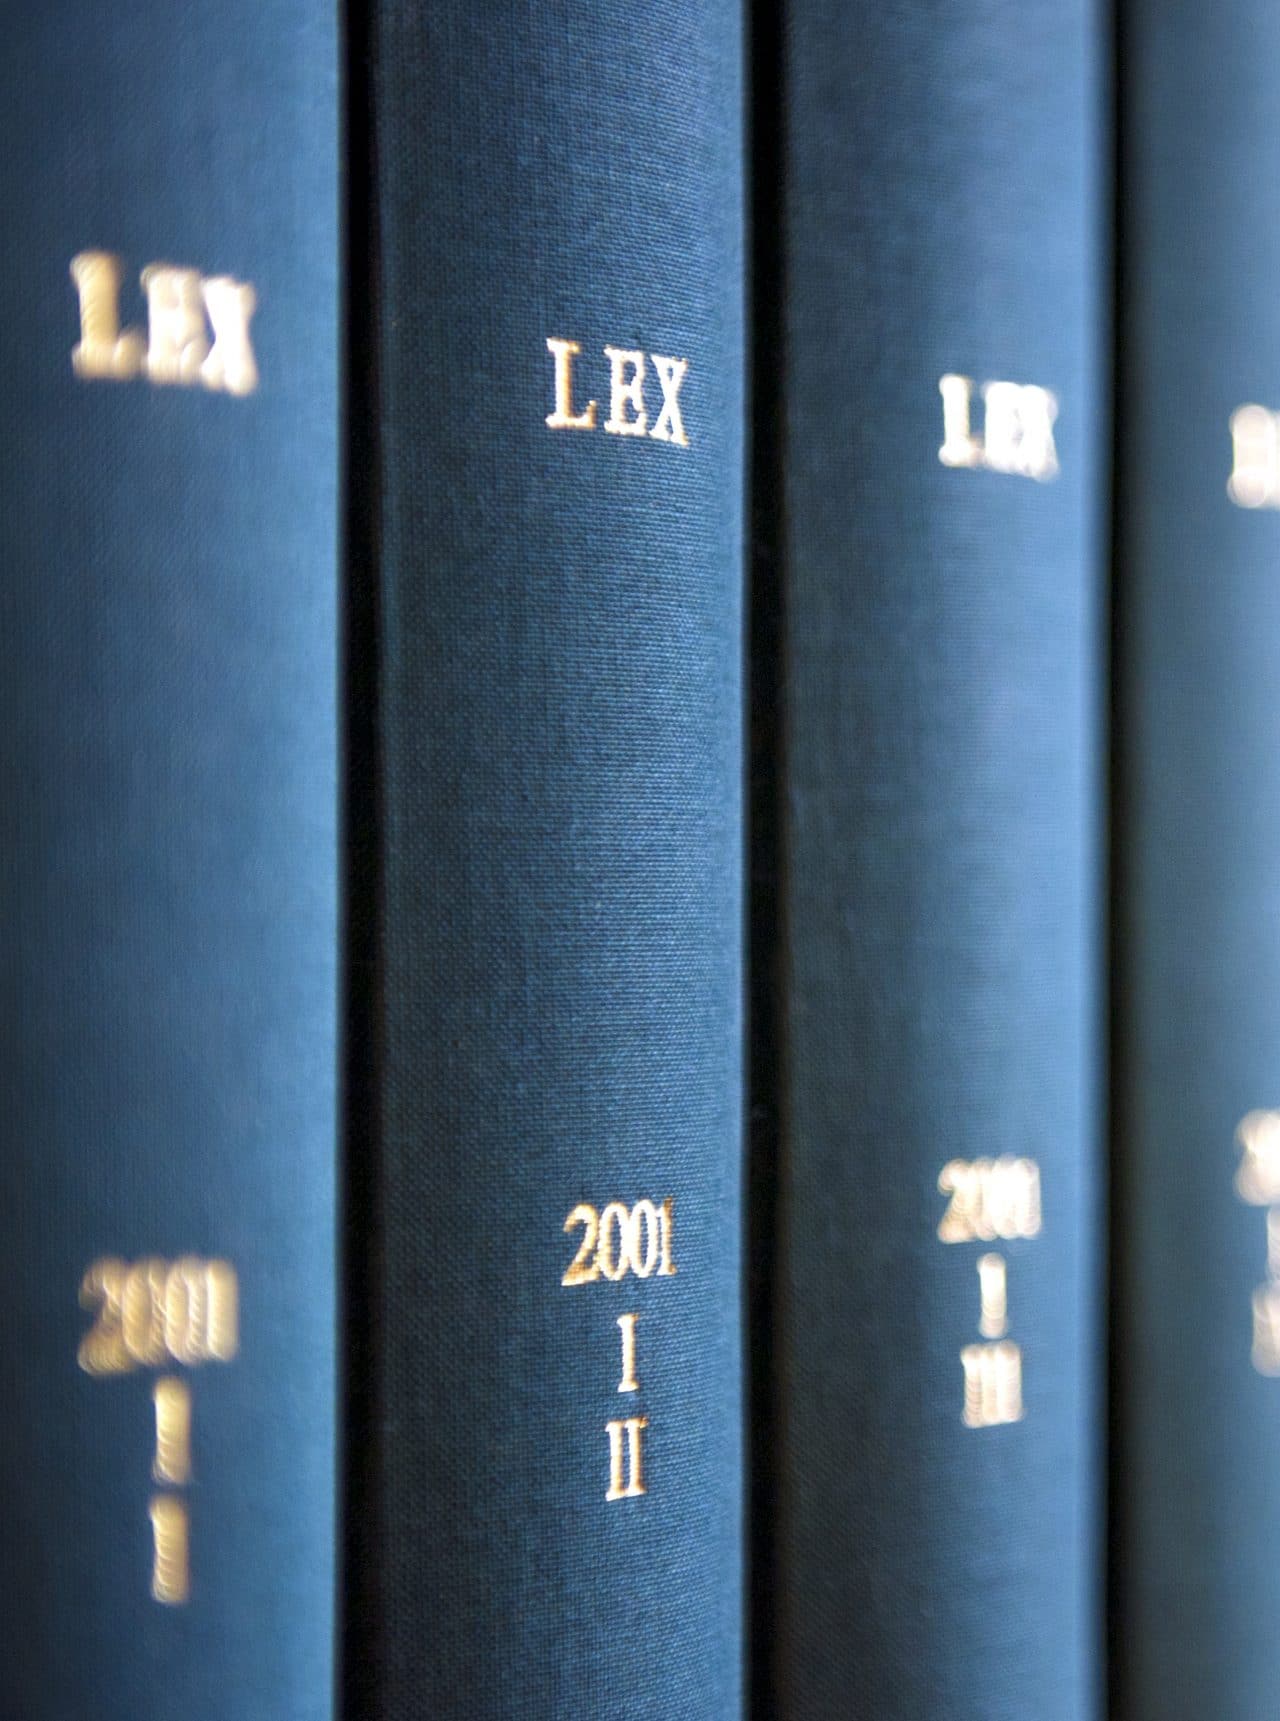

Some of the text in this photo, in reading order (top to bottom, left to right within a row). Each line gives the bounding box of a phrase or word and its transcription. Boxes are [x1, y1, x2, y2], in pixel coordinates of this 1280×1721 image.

[70, 251, 258, 396] LEX
[544, 337, 691, 448] LEX
[561, 1198, 678, 1287] 2001
[616, 1313, 640, 1393] I
[604, 1416, 650, 1502] II
